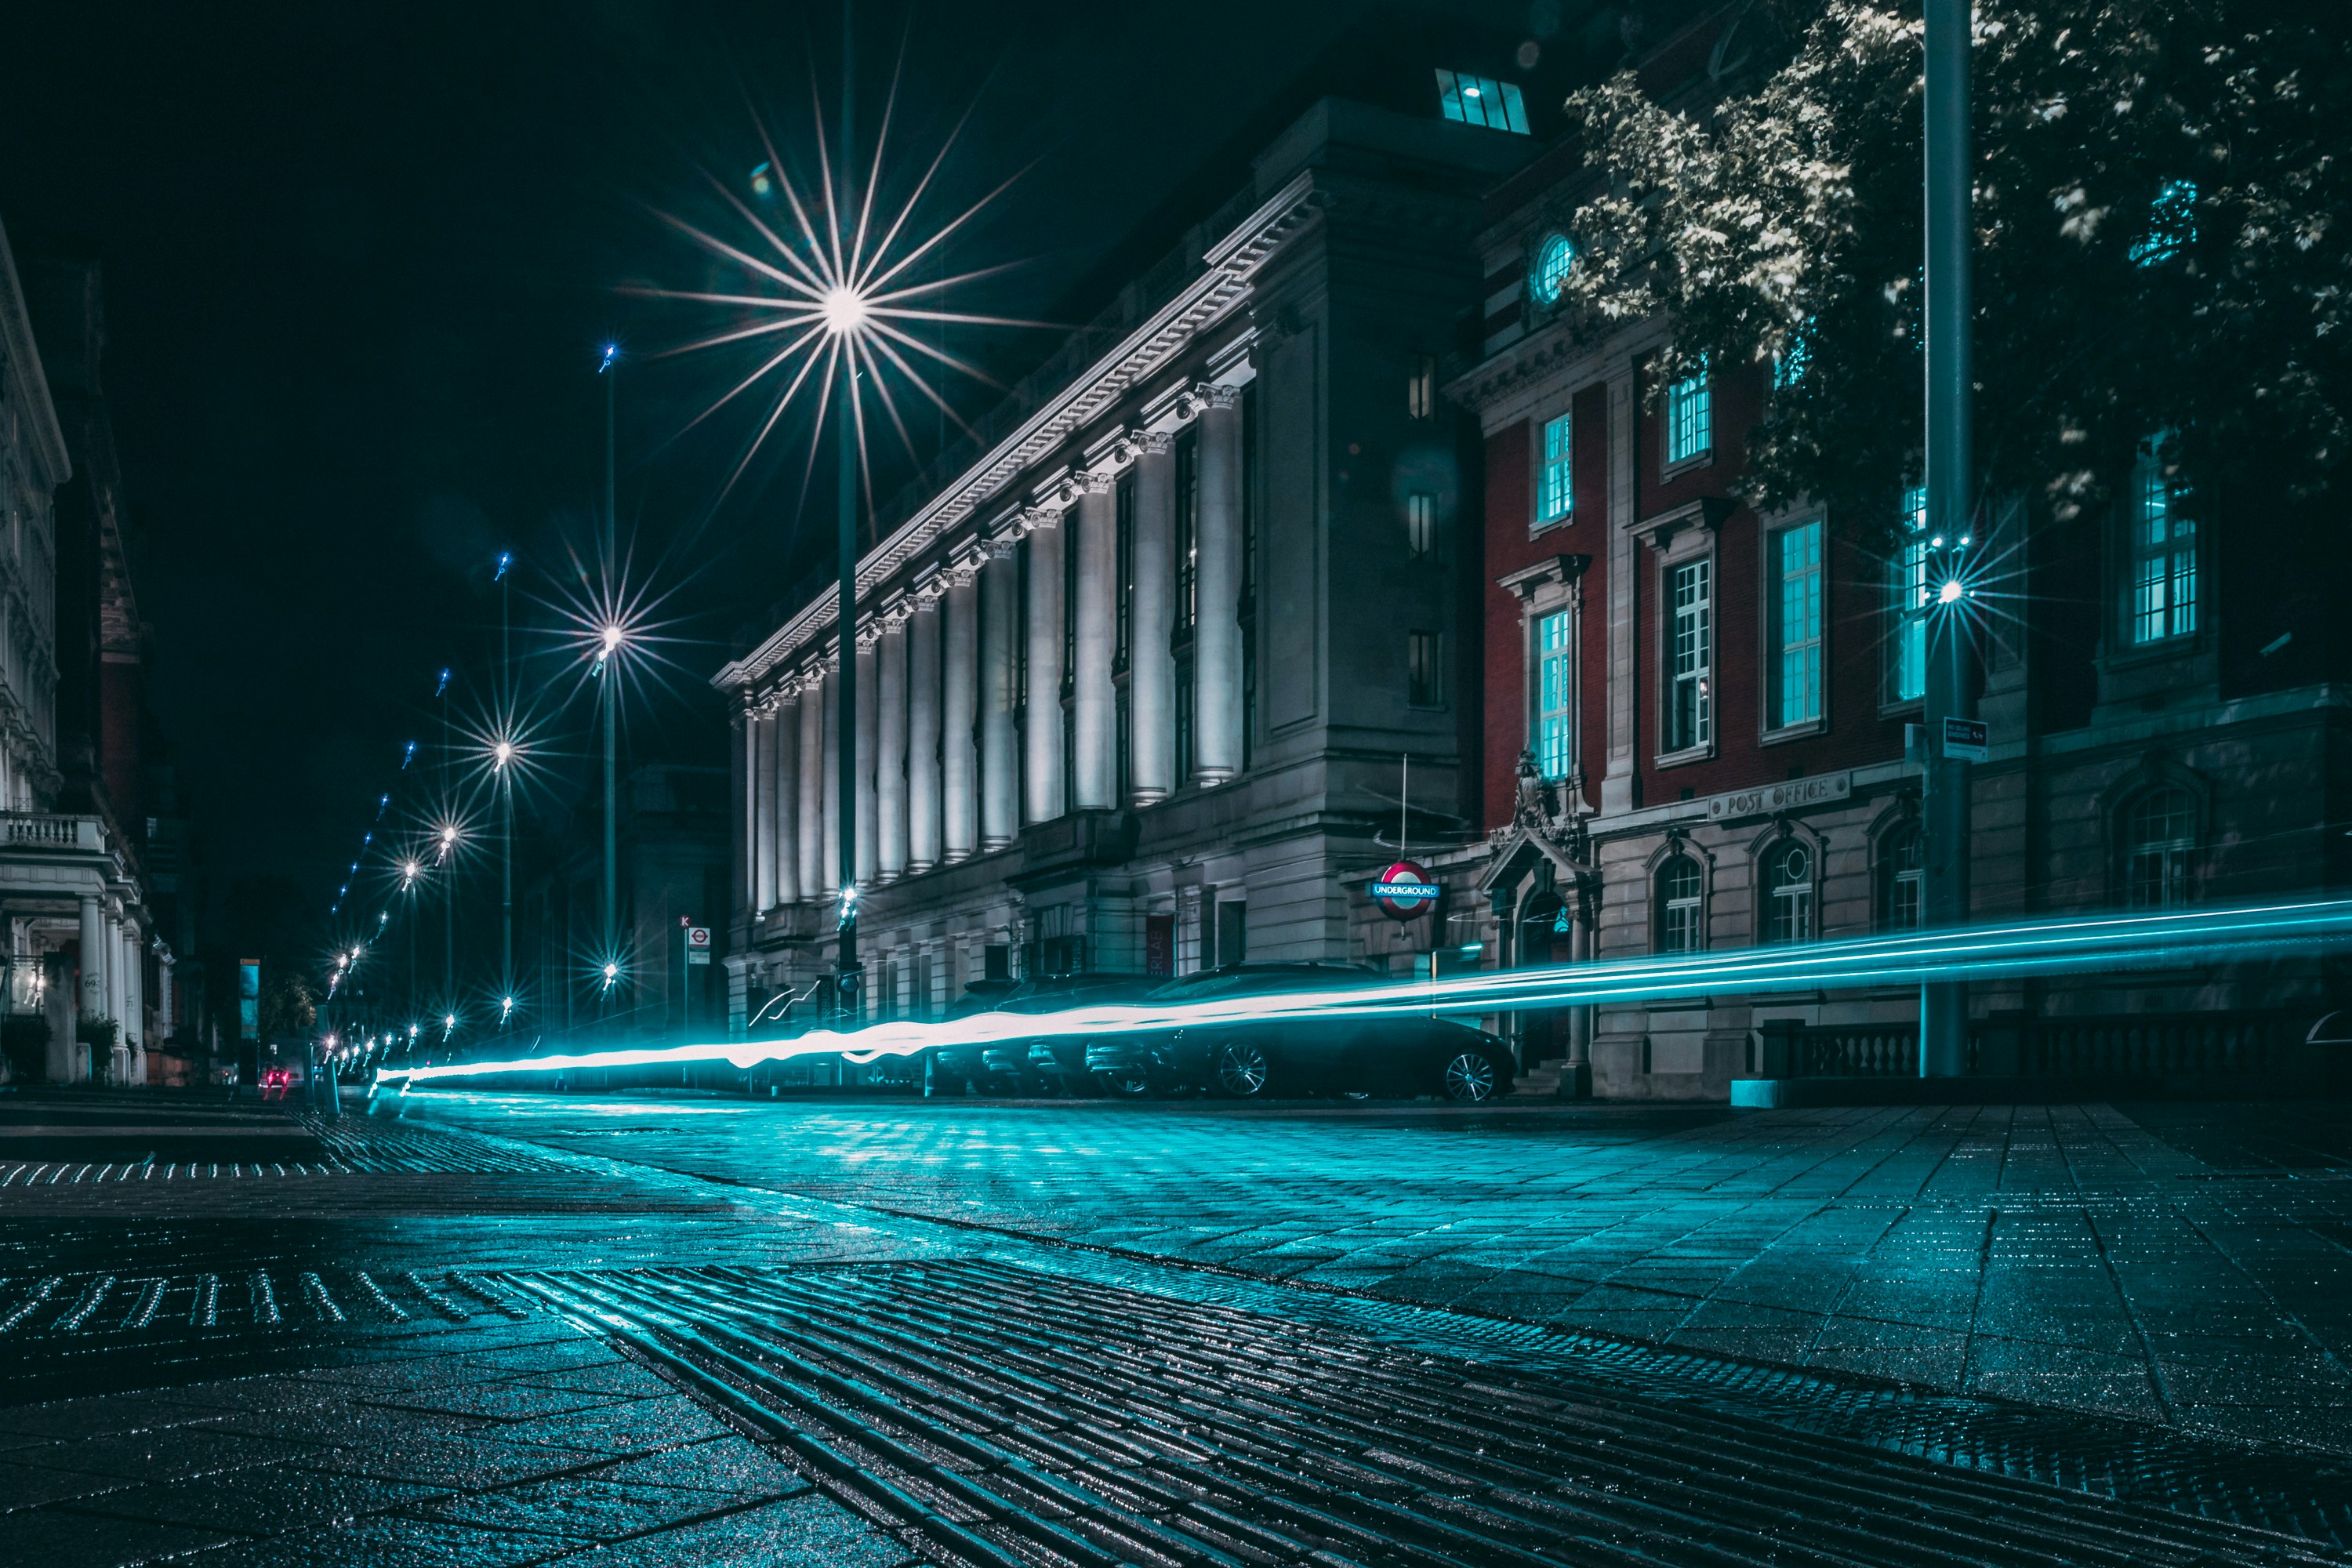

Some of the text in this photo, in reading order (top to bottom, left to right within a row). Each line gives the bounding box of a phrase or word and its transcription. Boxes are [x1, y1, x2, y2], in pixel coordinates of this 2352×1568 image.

[1728, 779, 1828, 814] POST OFFICE
[1374, 886, 1436, 895] UNDERGROUND
[681, 916, 689, 927] K
[821, 981, 830, 1028] PERBUGS
